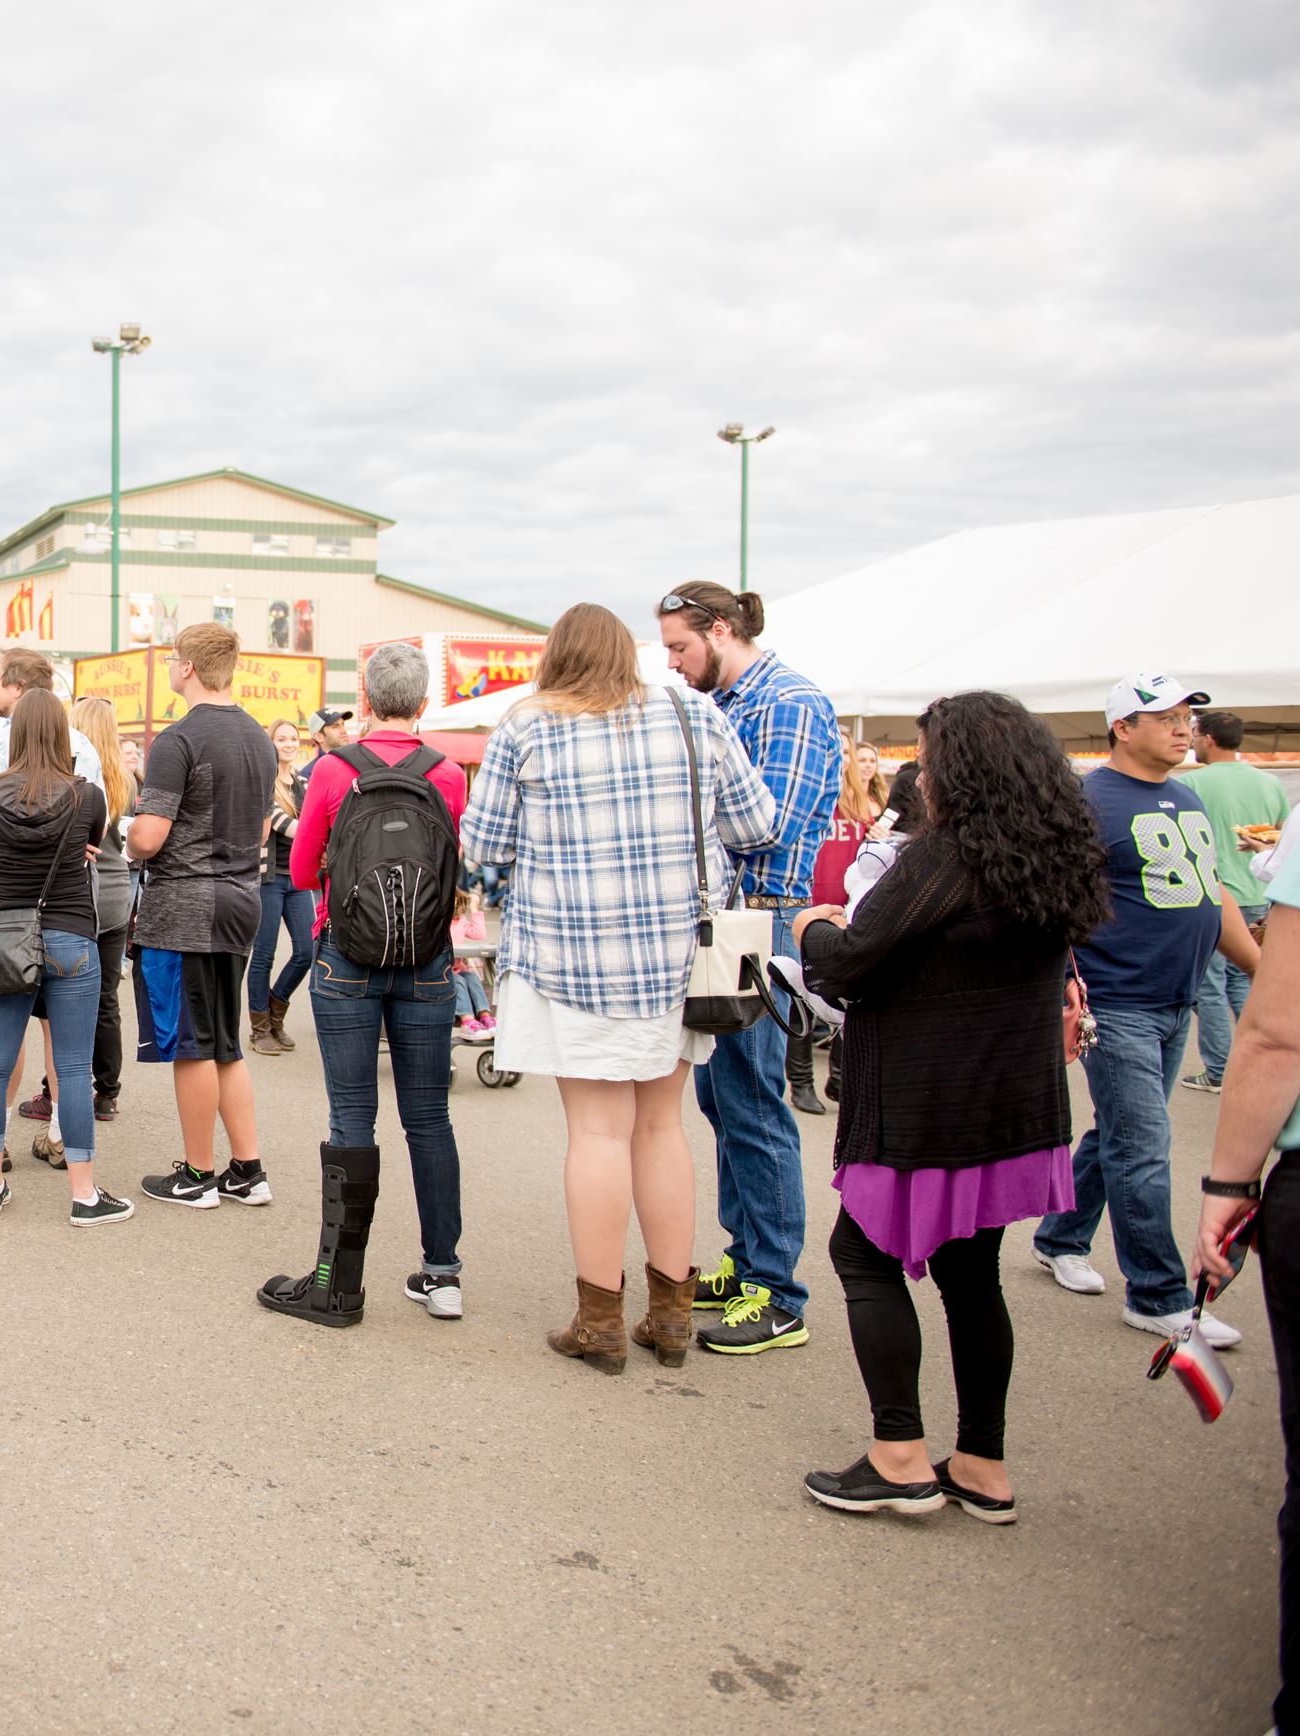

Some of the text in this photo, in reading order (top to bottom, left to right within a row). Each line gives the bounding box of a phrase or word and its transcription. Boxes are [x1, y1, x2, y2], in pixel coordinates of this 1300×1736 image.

[113, 682, 141, 698] BURST
[241, 685, 302, 701] BURST
[1131, 810, 1223, 909] 88
